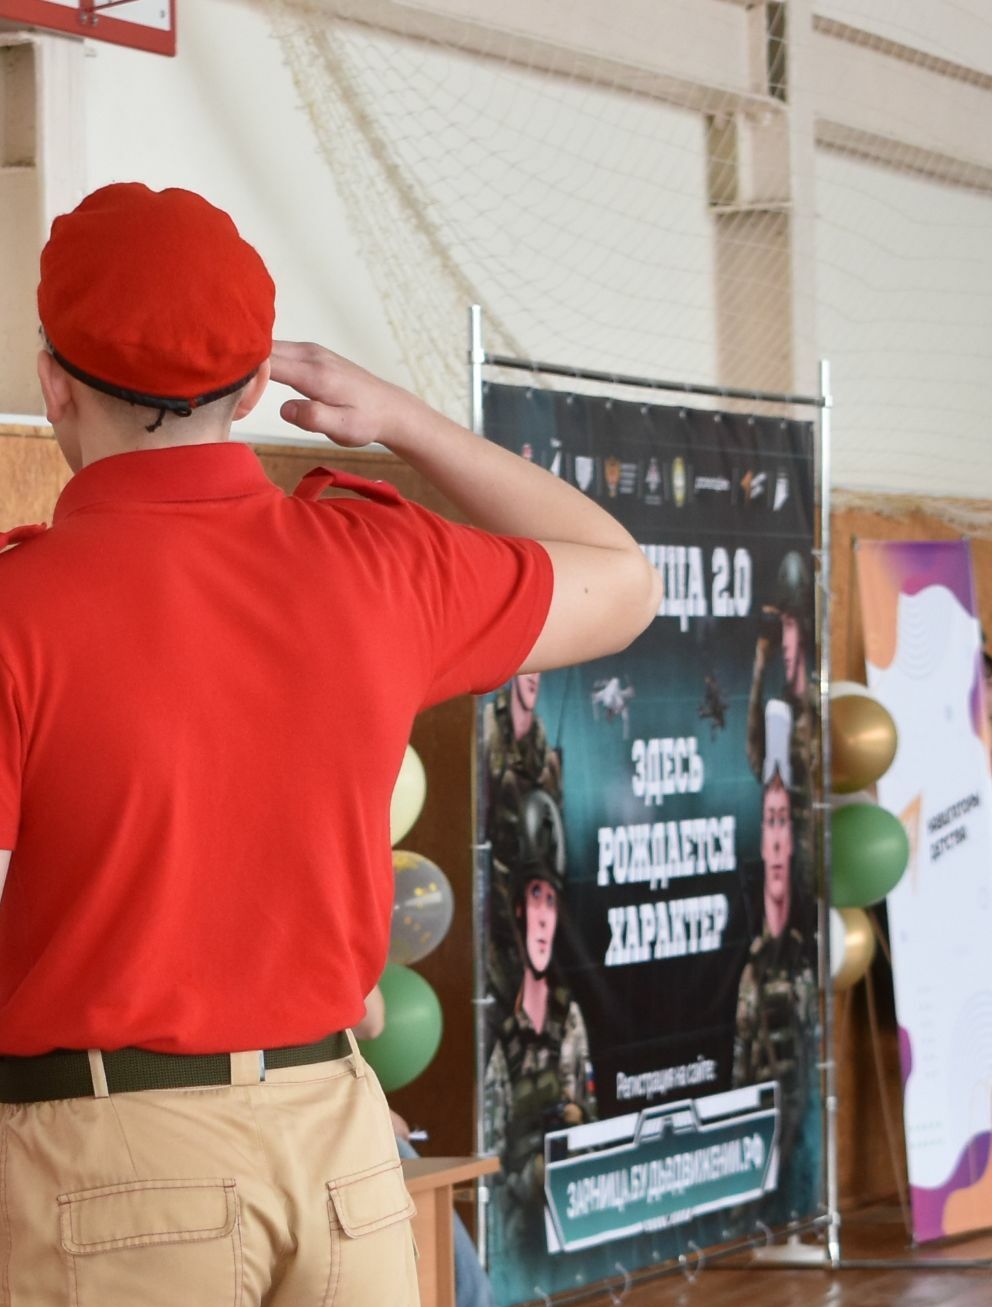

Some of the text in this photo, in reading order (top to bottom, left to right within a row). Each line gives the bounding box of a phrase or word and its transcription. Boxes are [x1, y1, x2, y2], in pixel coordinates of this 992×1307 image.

[711, 546, 752, 617] 2.0
[631, 736, 704, 806] ЗДЕСЬ
[597, 815, 737, 890] РОЖДАЕТСЯ
[604, 893, 729, 967] ХАРАКТЕР
